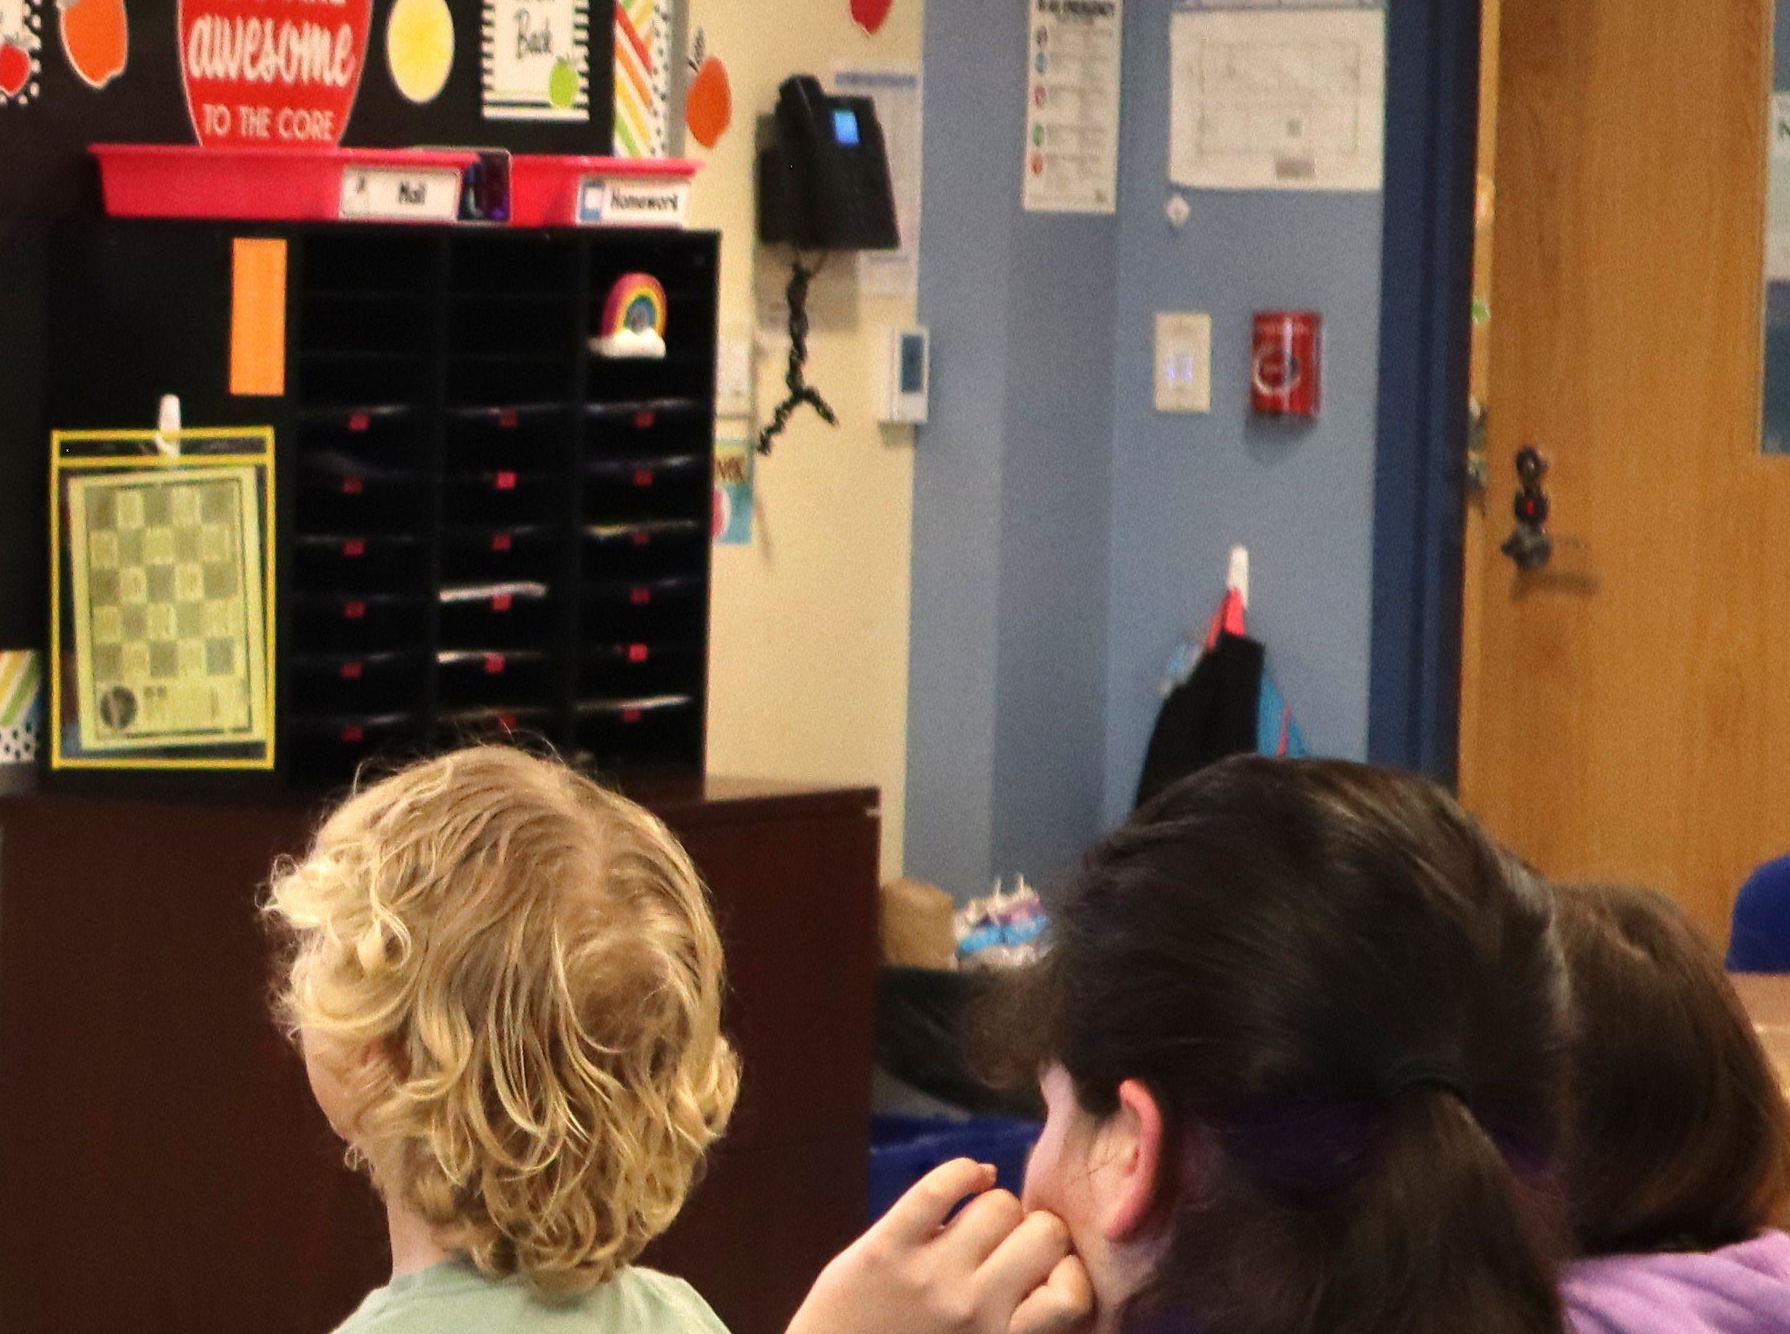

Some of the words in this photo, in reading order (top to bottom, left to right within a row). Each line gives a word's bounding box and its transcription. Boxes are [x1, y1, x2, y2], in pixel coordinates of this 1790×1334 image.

[187, 12, 357, 89] awesome
[202, 102, 232, 136] TO
[239, 104, 273, 138] THE
[277, 106, 337, 143] CORE
[397, 180, 427, 207] Mail
[609, 191, 680, 213] Homework
